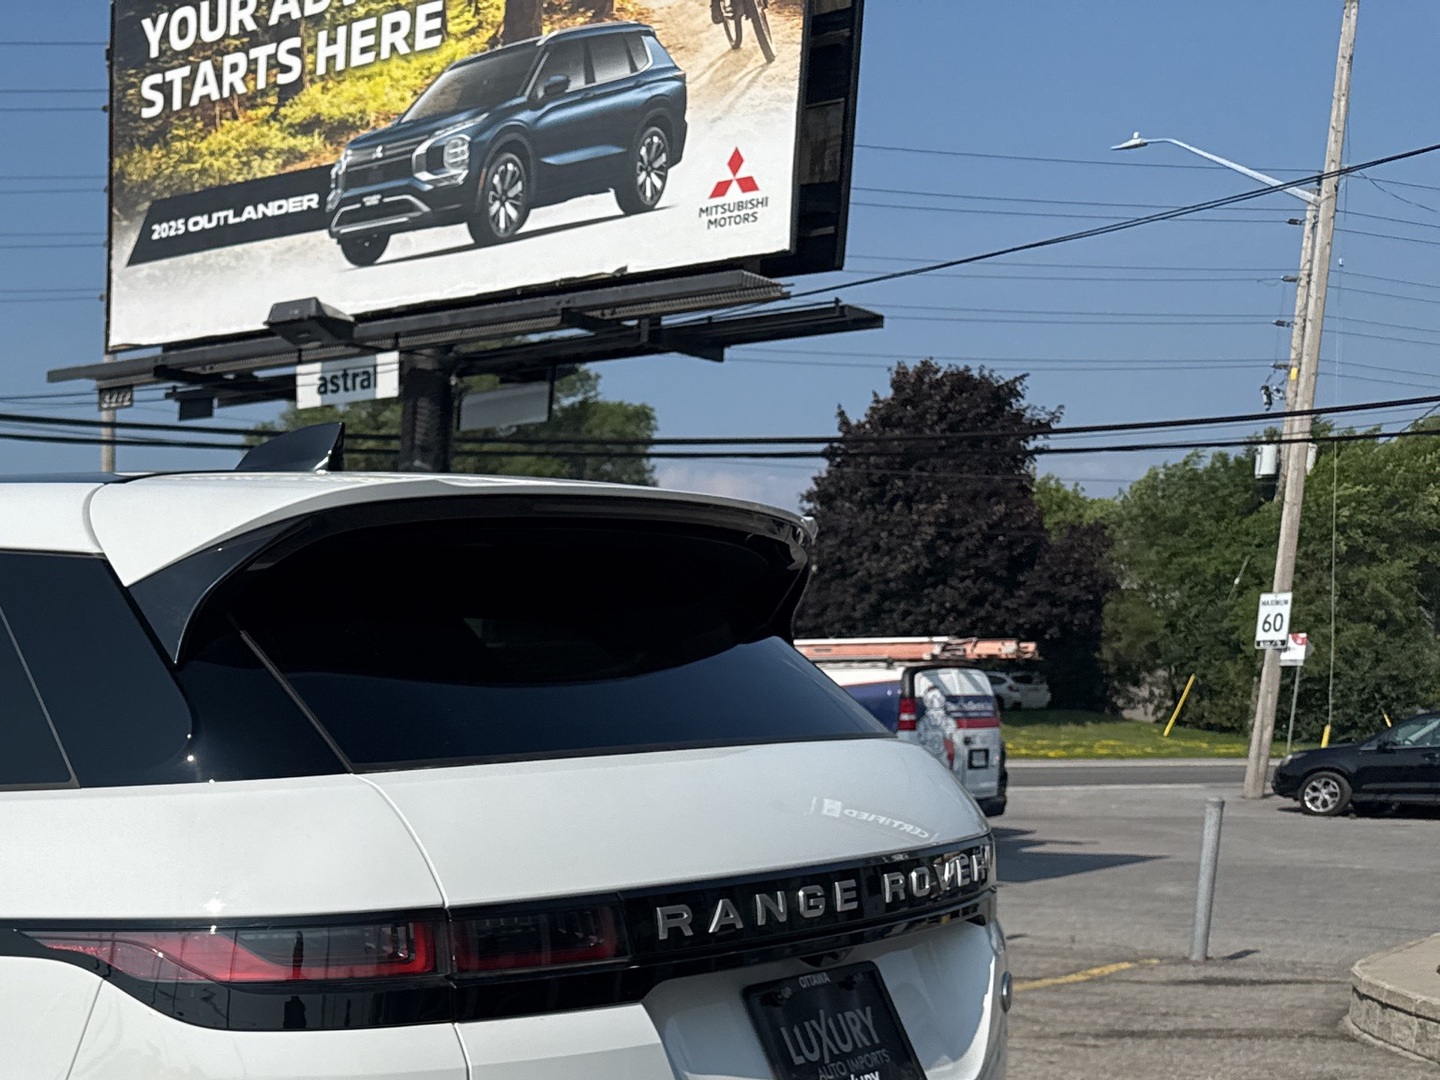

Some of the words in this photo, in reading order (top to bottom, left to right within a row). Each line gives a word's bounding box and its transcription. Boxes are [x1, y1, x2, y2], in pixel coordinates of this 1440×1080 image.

[141, 0, 257, 58] YOUR
[140, 36, 303, 118] STARTS
[316, 0, 443, 75] HERE
[151, 218, 186, 241] 2025
[187, 193, 320, 232] OUTLANDER
[698, 196, 769, 218] MITSUBISHI
[707, 211, 758, 230] MOTORS
[317, 365, 377, 395] astral
[1262, 612, 1284, 632] 60
[656, 879, 859, 940] RANGE
[882, 847, 989, 904] ROVER
[799, 972, 831, 989] OTTAWA
[780, 1006, 880, 1065] LUXURY
[818, 1063, 847, 1080] AUTO
[847, 1049, 891, 1073] IMPORTS
